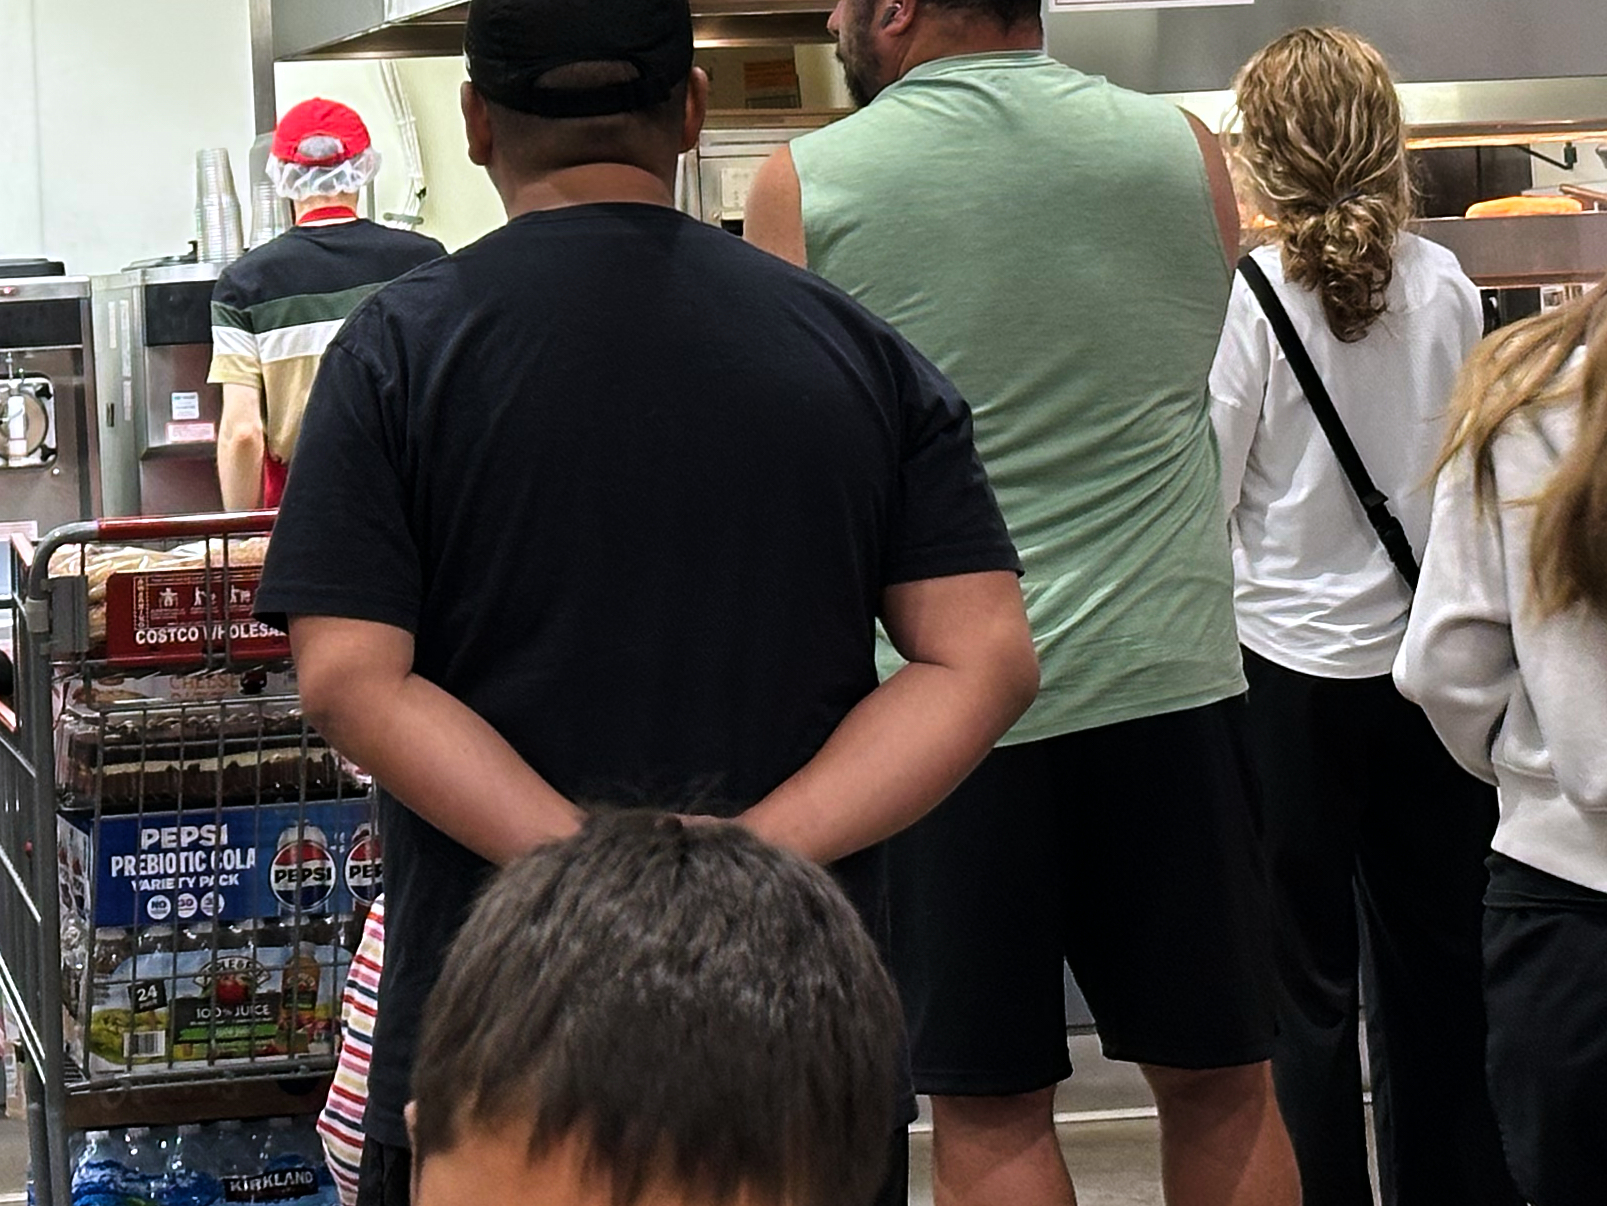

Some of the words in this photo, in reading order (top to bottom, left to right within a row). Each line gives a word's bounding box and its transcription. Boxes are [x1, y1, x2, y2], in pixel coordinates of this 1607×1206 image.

[135, 627, 199, 645] COSTCO
[140, 823, 228, 850] PEPSI
[111, 851, 207, 878] PREBIOTIC
[274, 867, 332, 884] PEPSI
[137, 984, 158, 1002] 24
[234, 1003, 271, 1018] JUICE
[230, 1171, 314, 1192] KIRKLAND
